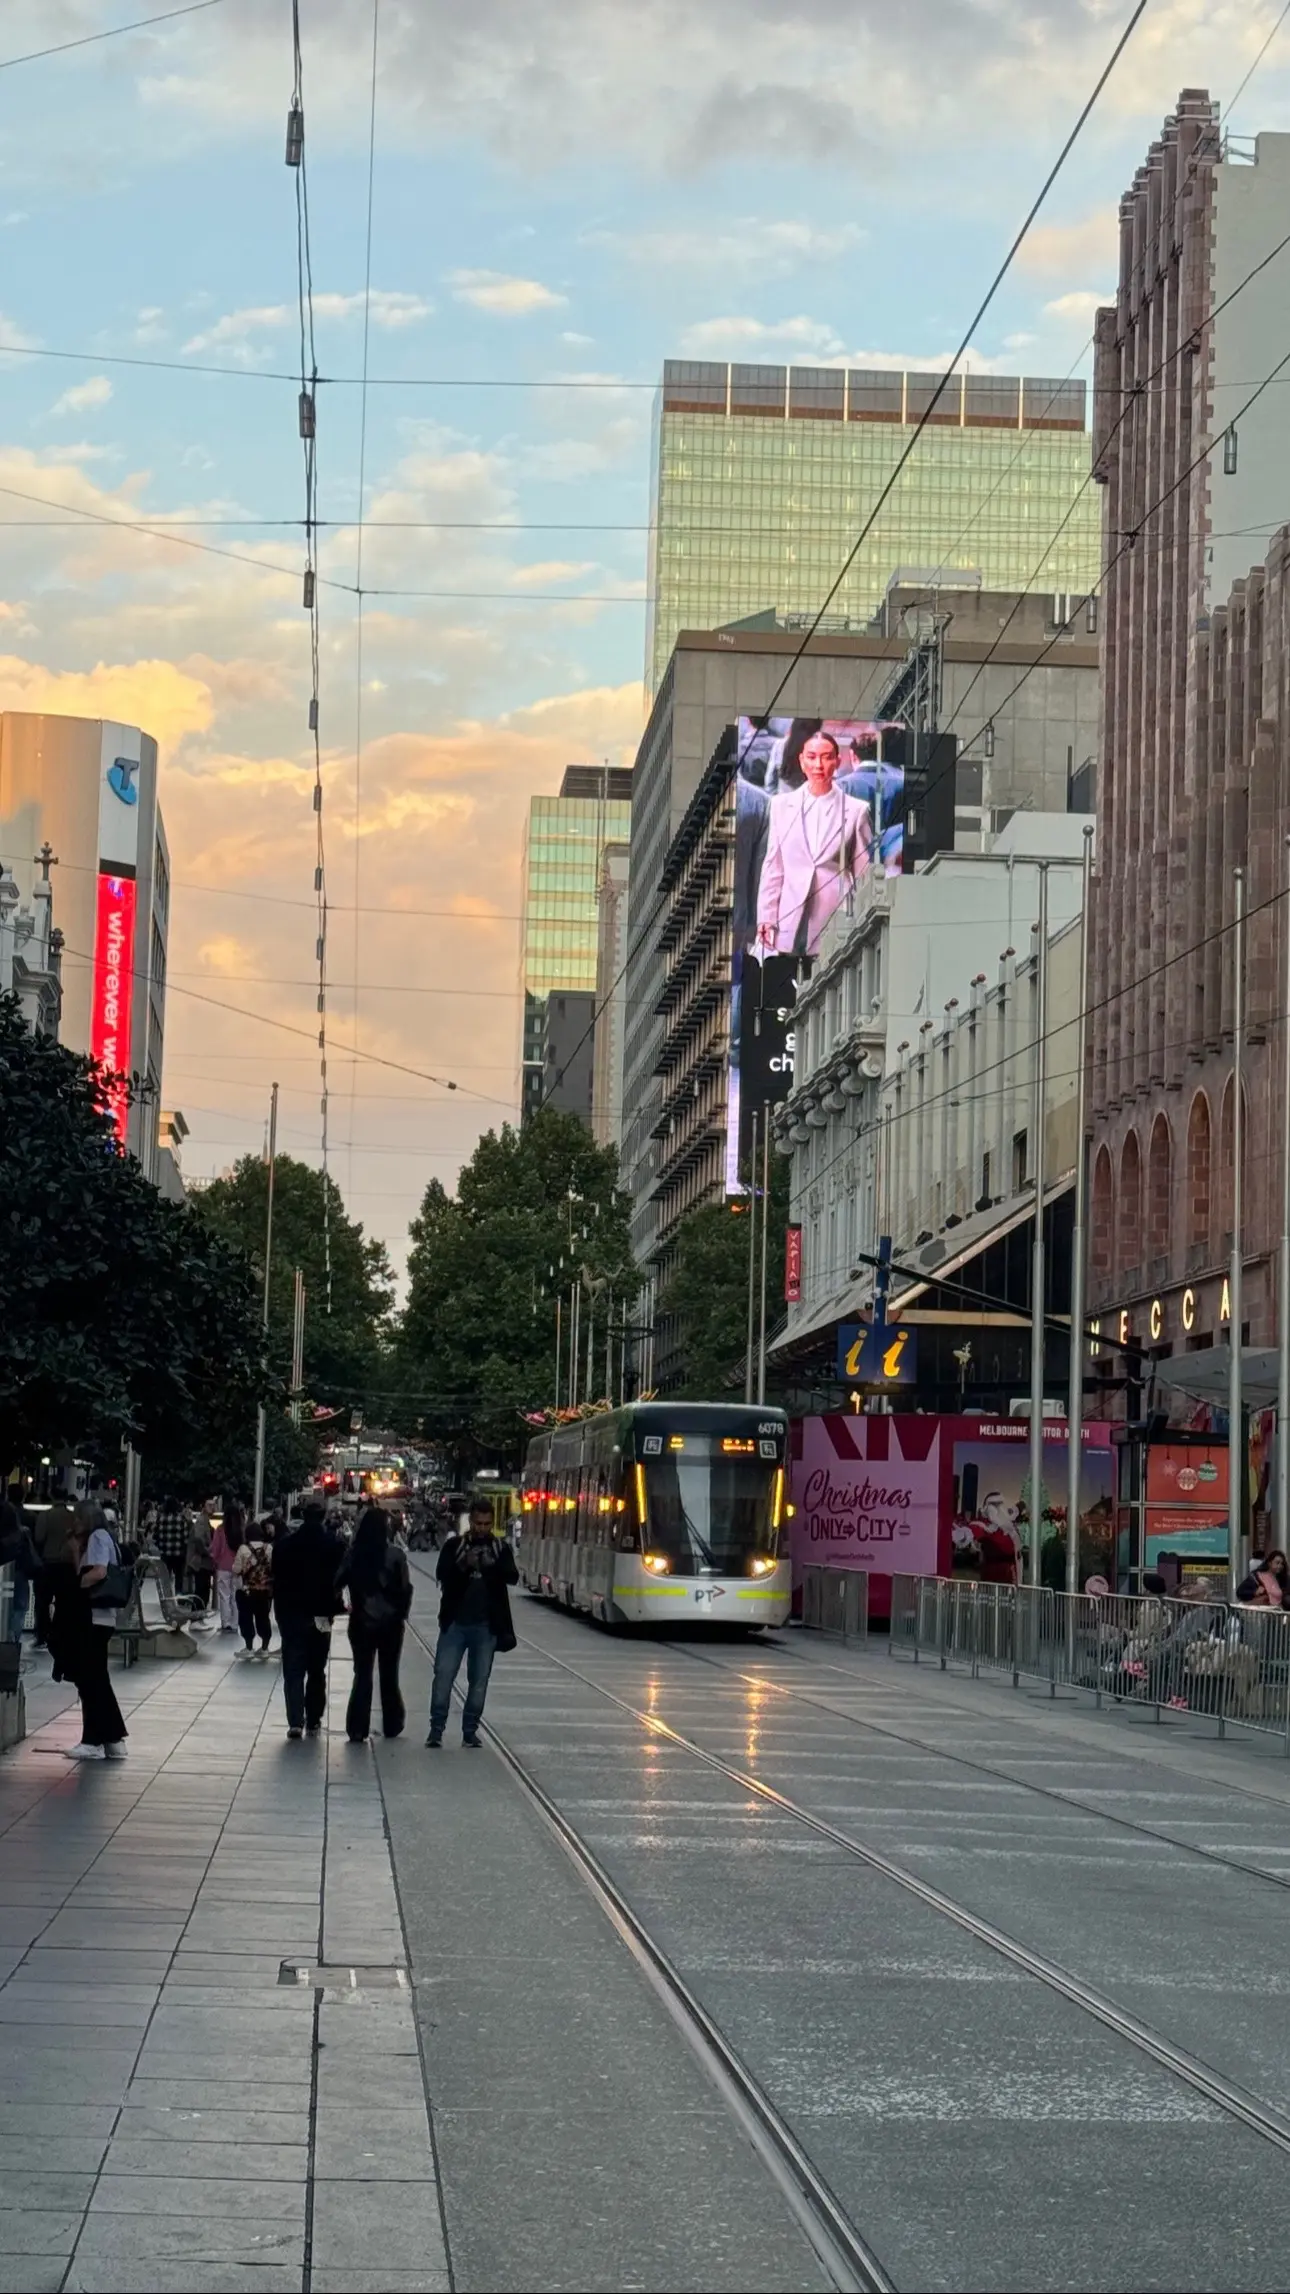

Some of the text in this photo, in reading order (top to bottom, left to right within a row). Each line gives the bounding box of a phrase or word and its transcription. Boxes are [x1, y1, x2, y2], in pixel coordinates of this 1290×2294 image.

[103, 911, 125, 1032] wherever
[788, 1231, 799, 1296] VAPIAO
[1090, 1278, 1231, 1356] MECCA
[979, 1424, 1028, 1436] MELBOURNE
[1064, 1428, 1090, 1438] BTH
[803, 1469, 912, 1514] Christmas
[857, 1515, 897, 1541] CITY
